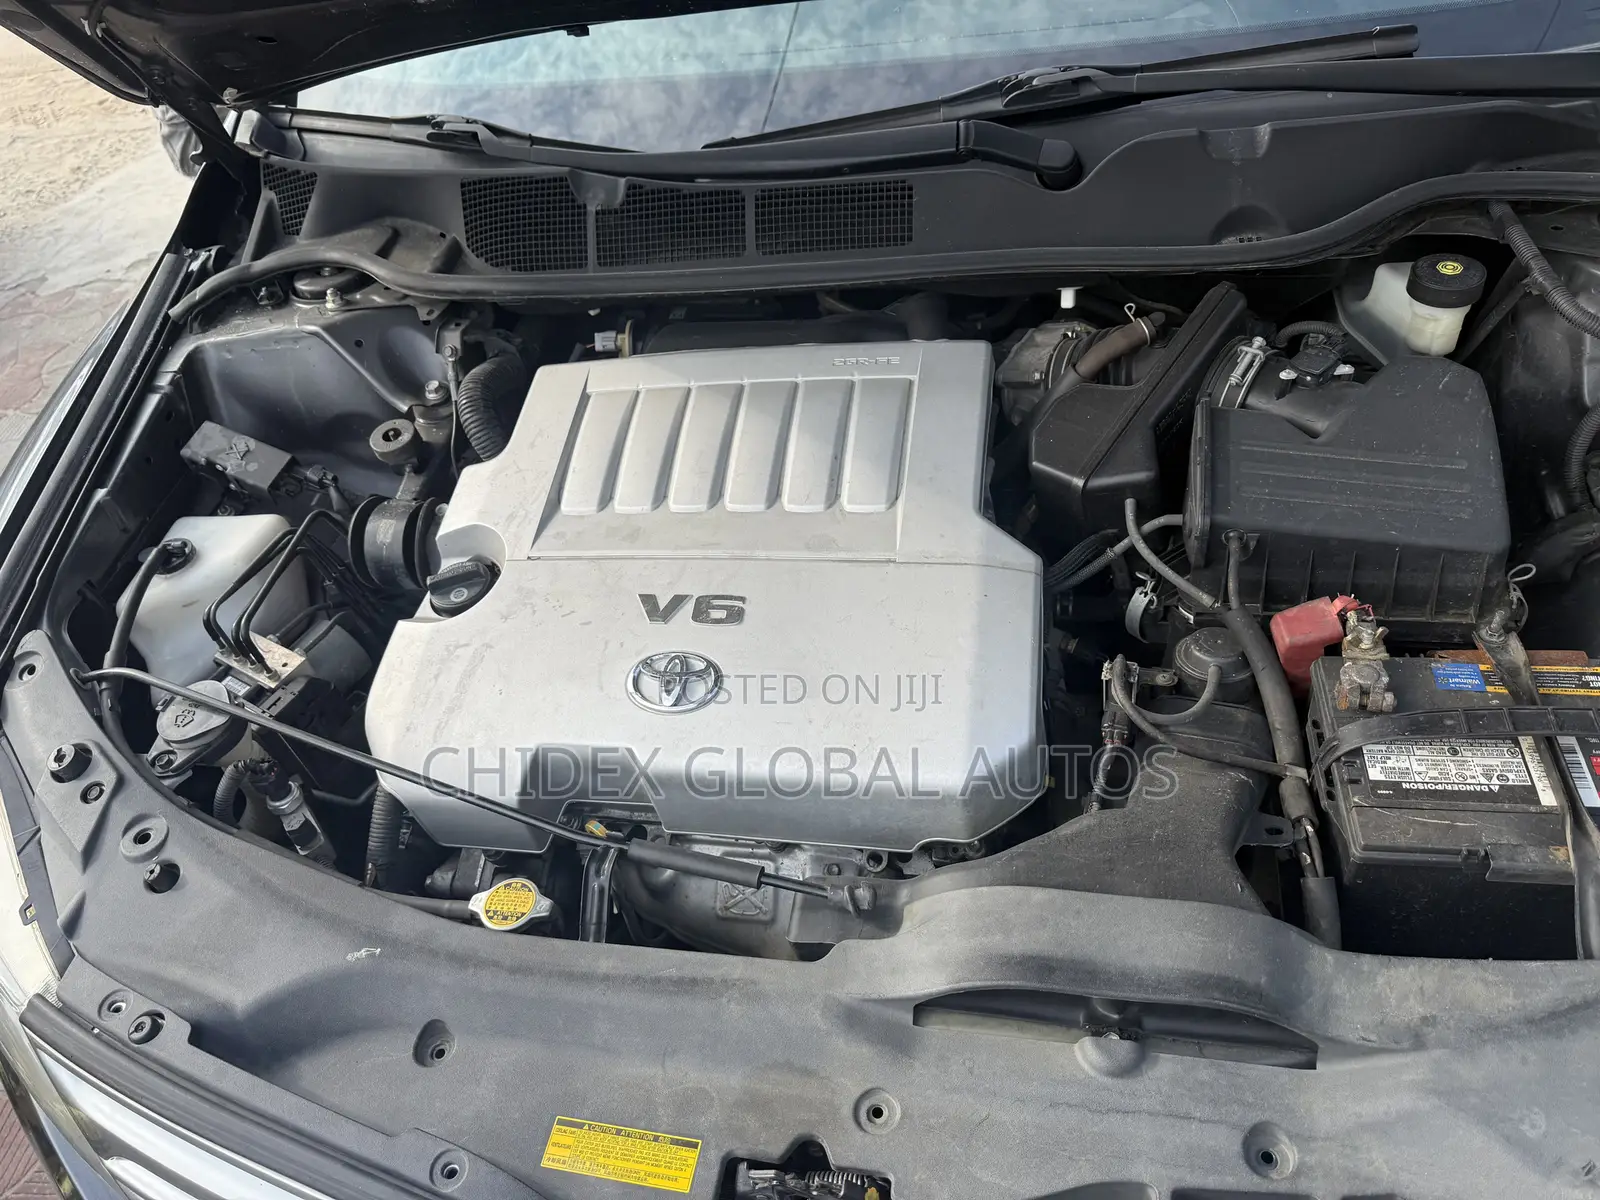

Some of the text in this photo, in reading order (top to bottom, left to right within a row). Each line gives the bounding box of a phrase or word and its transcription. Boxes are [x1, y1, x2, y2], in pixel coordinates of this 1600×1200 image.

[637, 594, 747, 626] V6
[1401, 782, 1490, 792] DANGER/POISON
[589, 1124, 654, 1141] CAUTION ATTENTION
